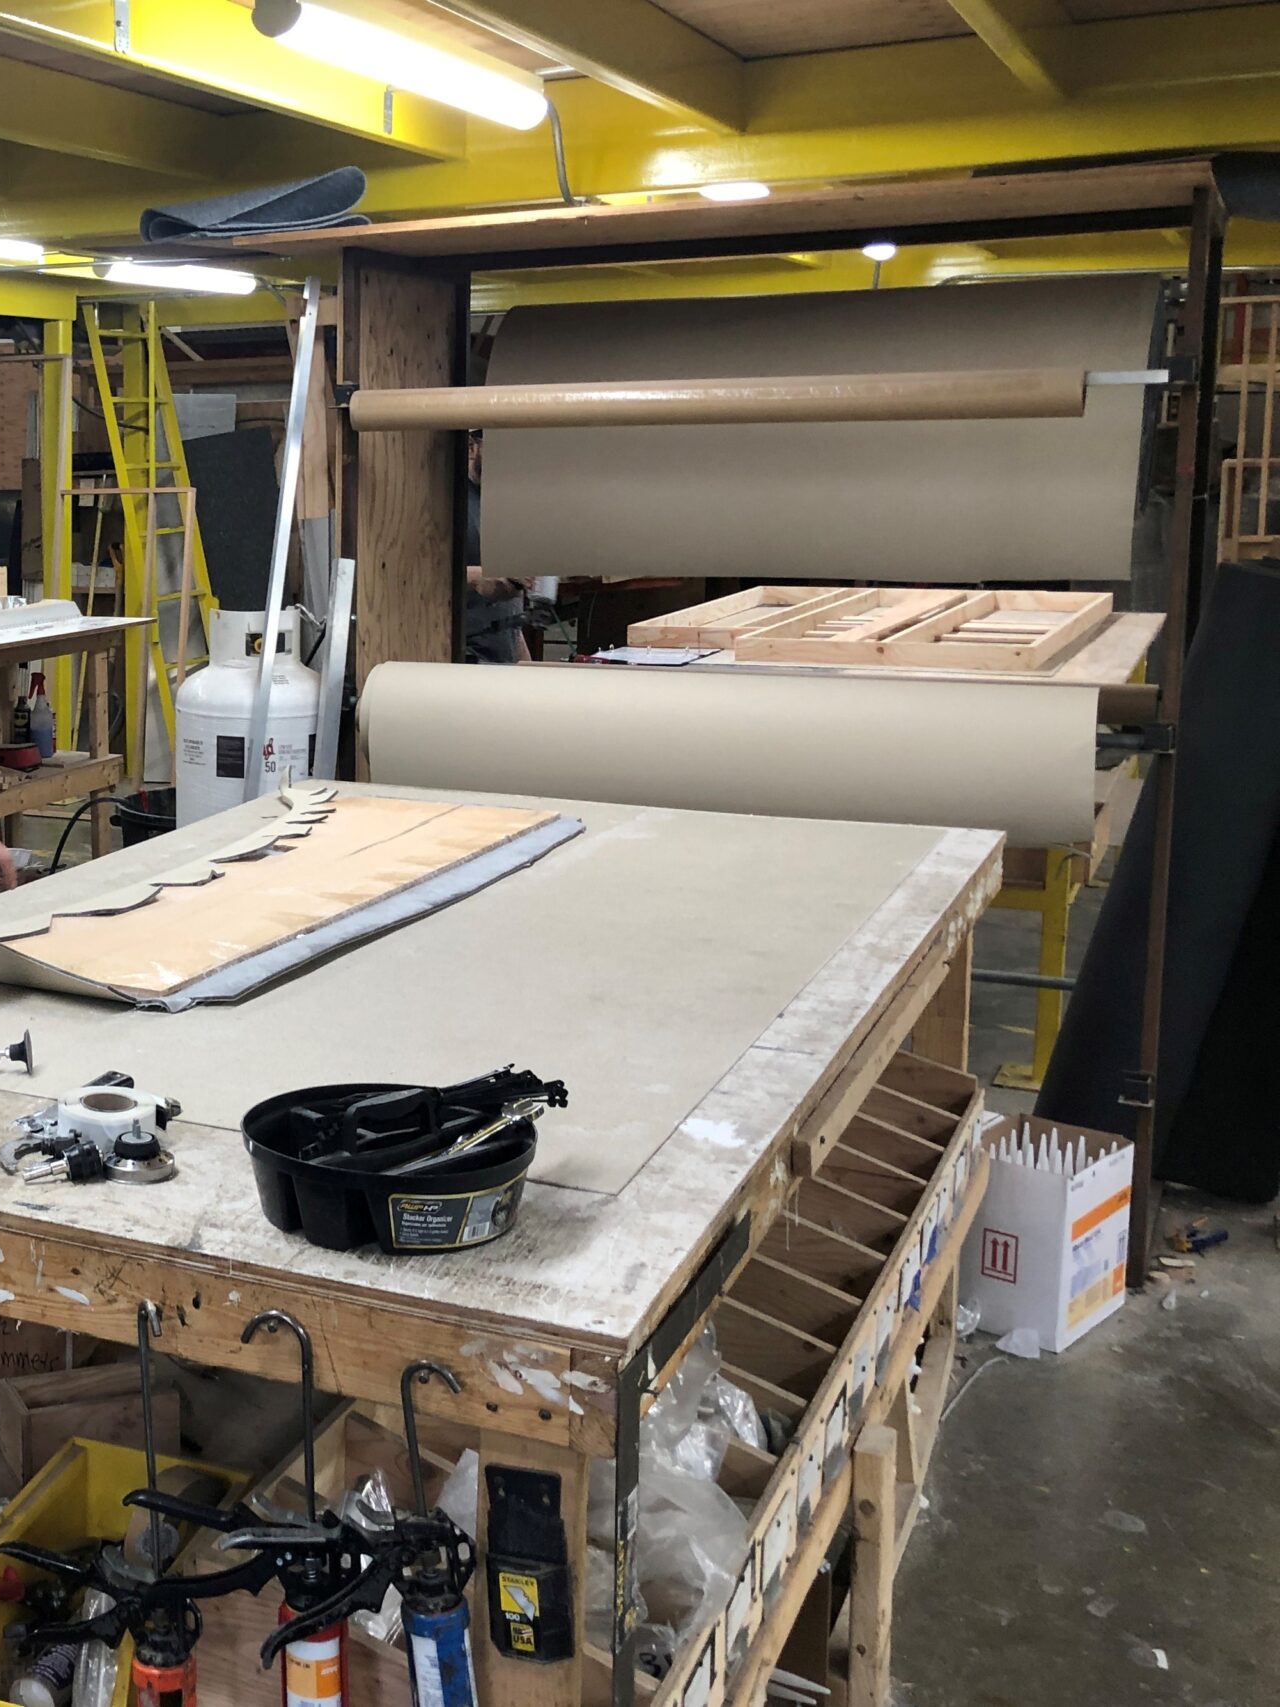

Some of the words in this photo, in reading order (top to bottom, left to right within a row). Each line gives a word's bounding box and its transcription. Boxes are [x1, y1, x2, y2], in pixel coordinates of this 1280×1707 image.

[265, 761, 276, 772] 50
[402, 1213, 426, 1221] Stacker
[426, 1214, 453, 1224] Organizer
[501, 1575, 535, 1587] STANLEY
[505, 1611, 521, 1621] 100
[513, 1635, 534, 1646] USA
